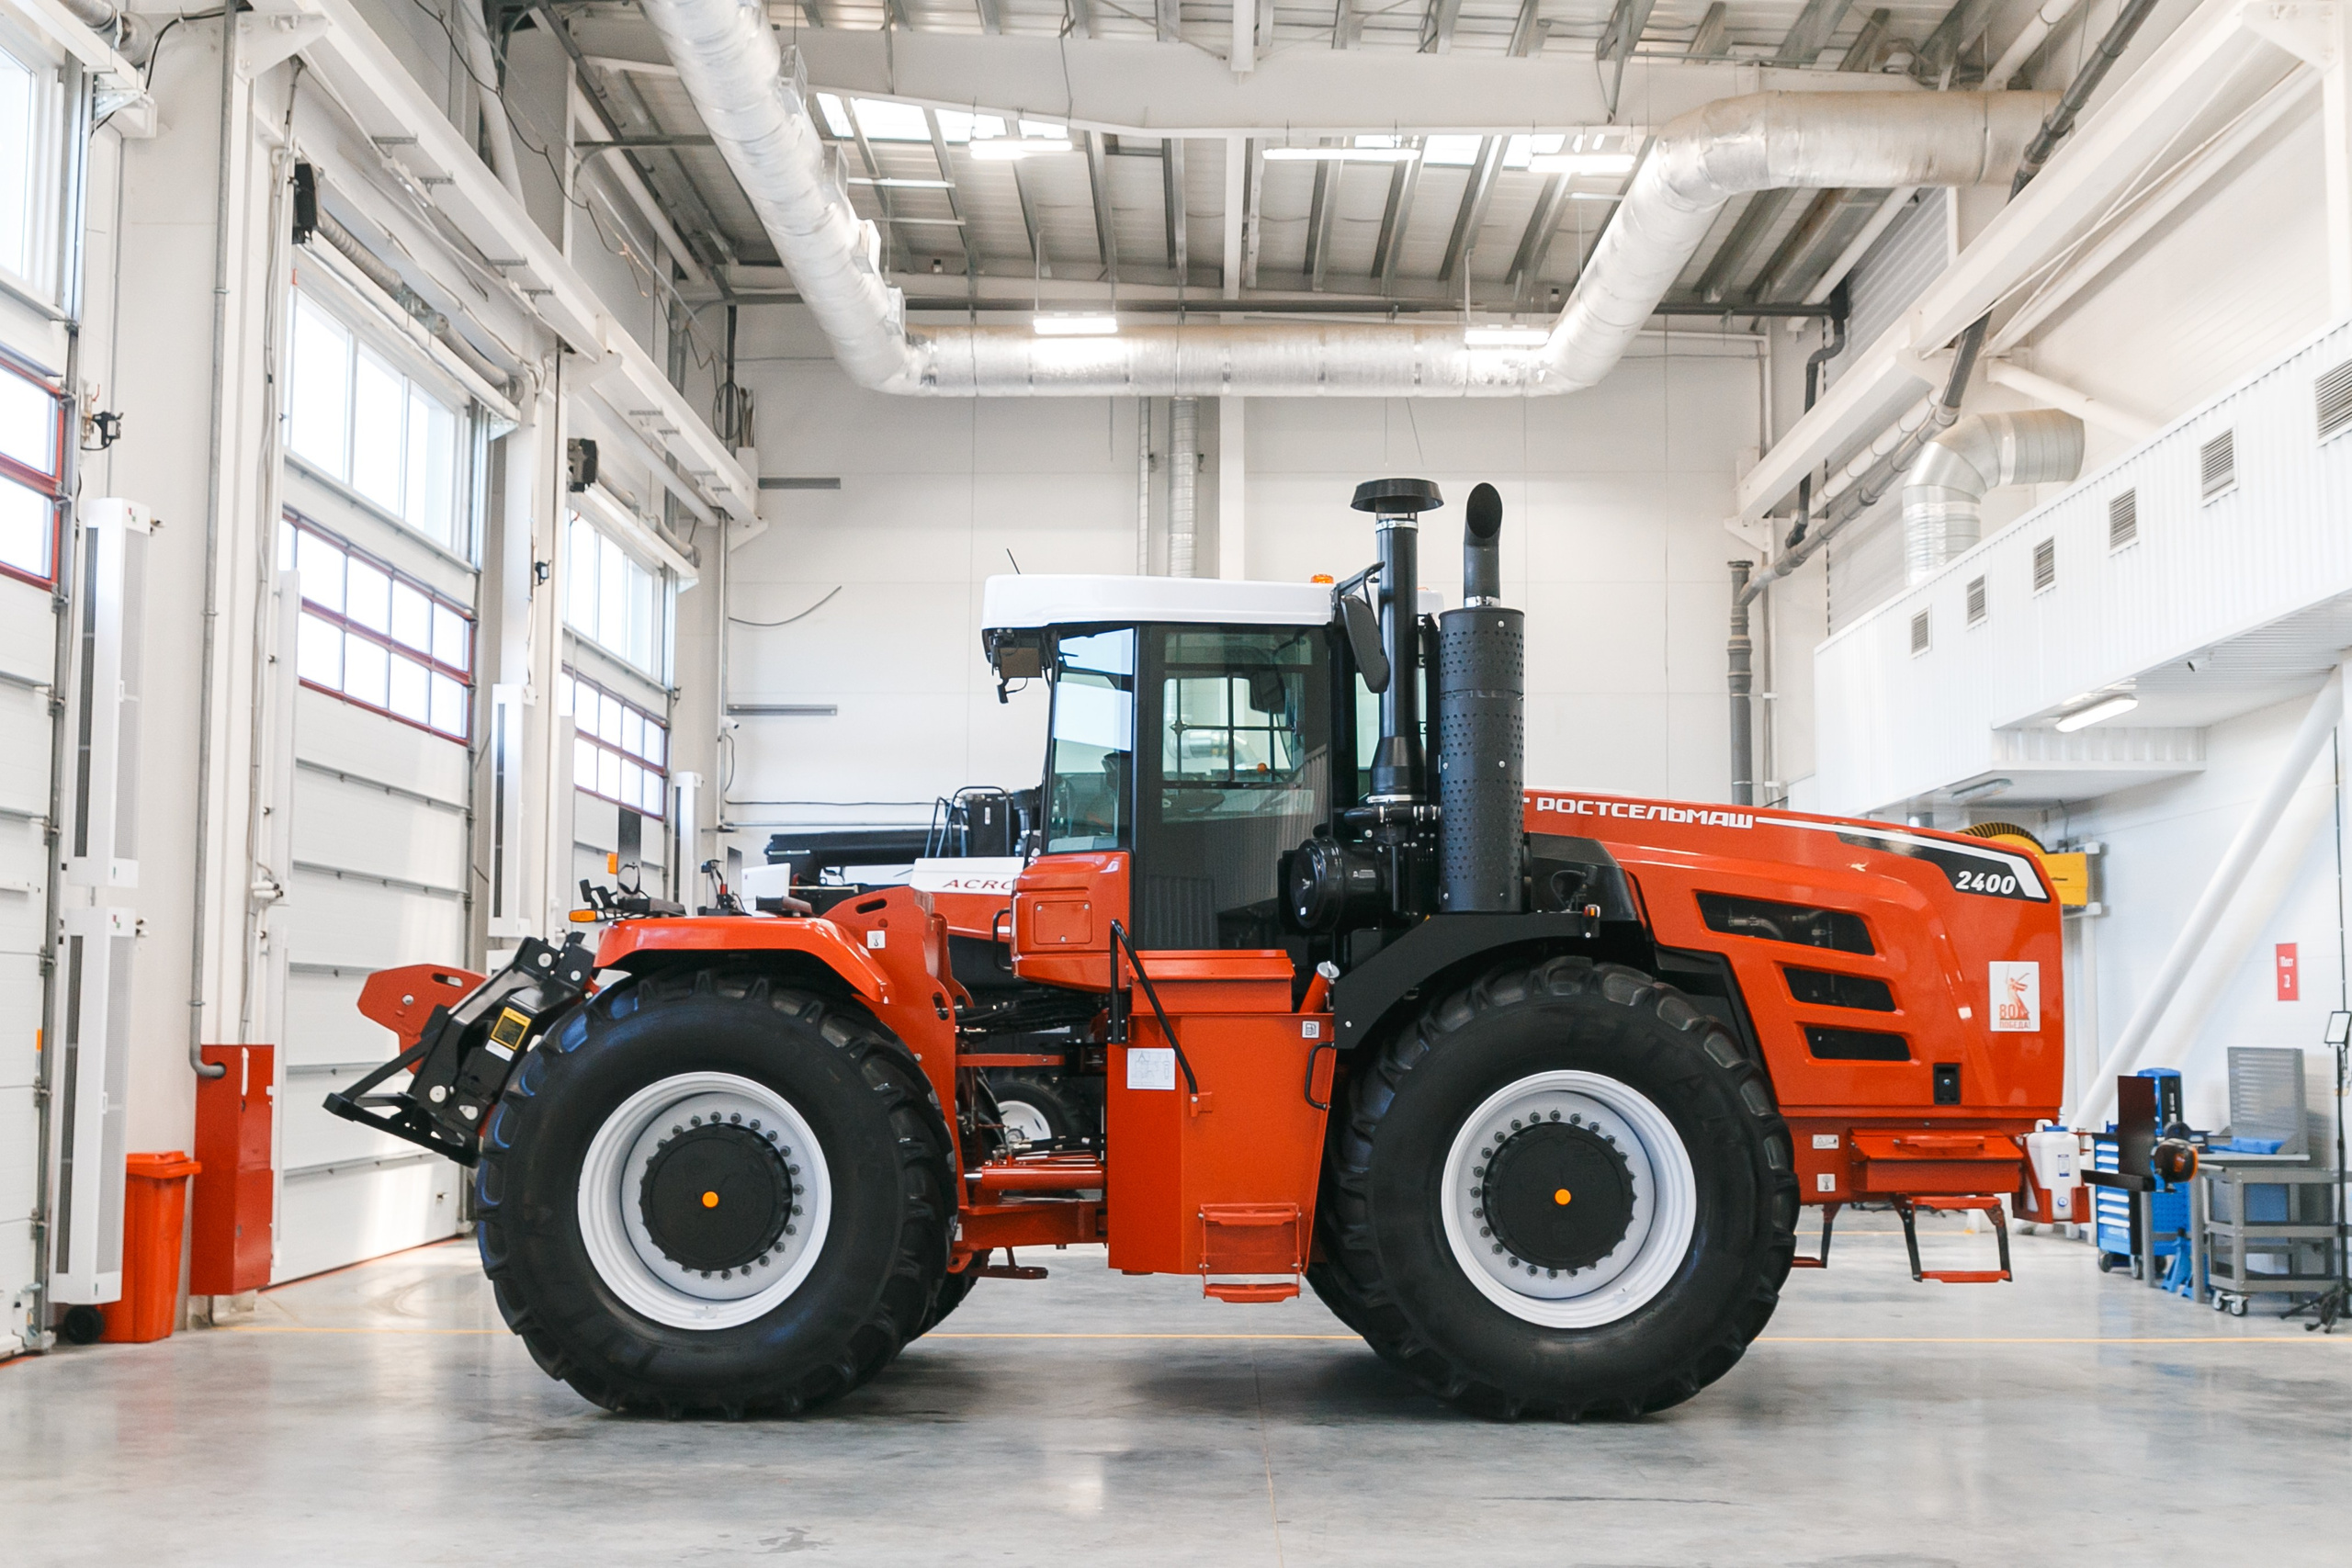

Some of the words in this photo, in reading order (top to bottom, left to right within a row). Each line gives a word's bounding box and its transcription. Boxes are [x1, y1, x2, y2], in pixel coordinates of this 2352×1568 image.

[1537, 797, 1753, 829] РОСТСЕЛЬМАШ
[1955, 870, 2016, 895] 2400
[1999, 1004, 2016, 1019] 80
